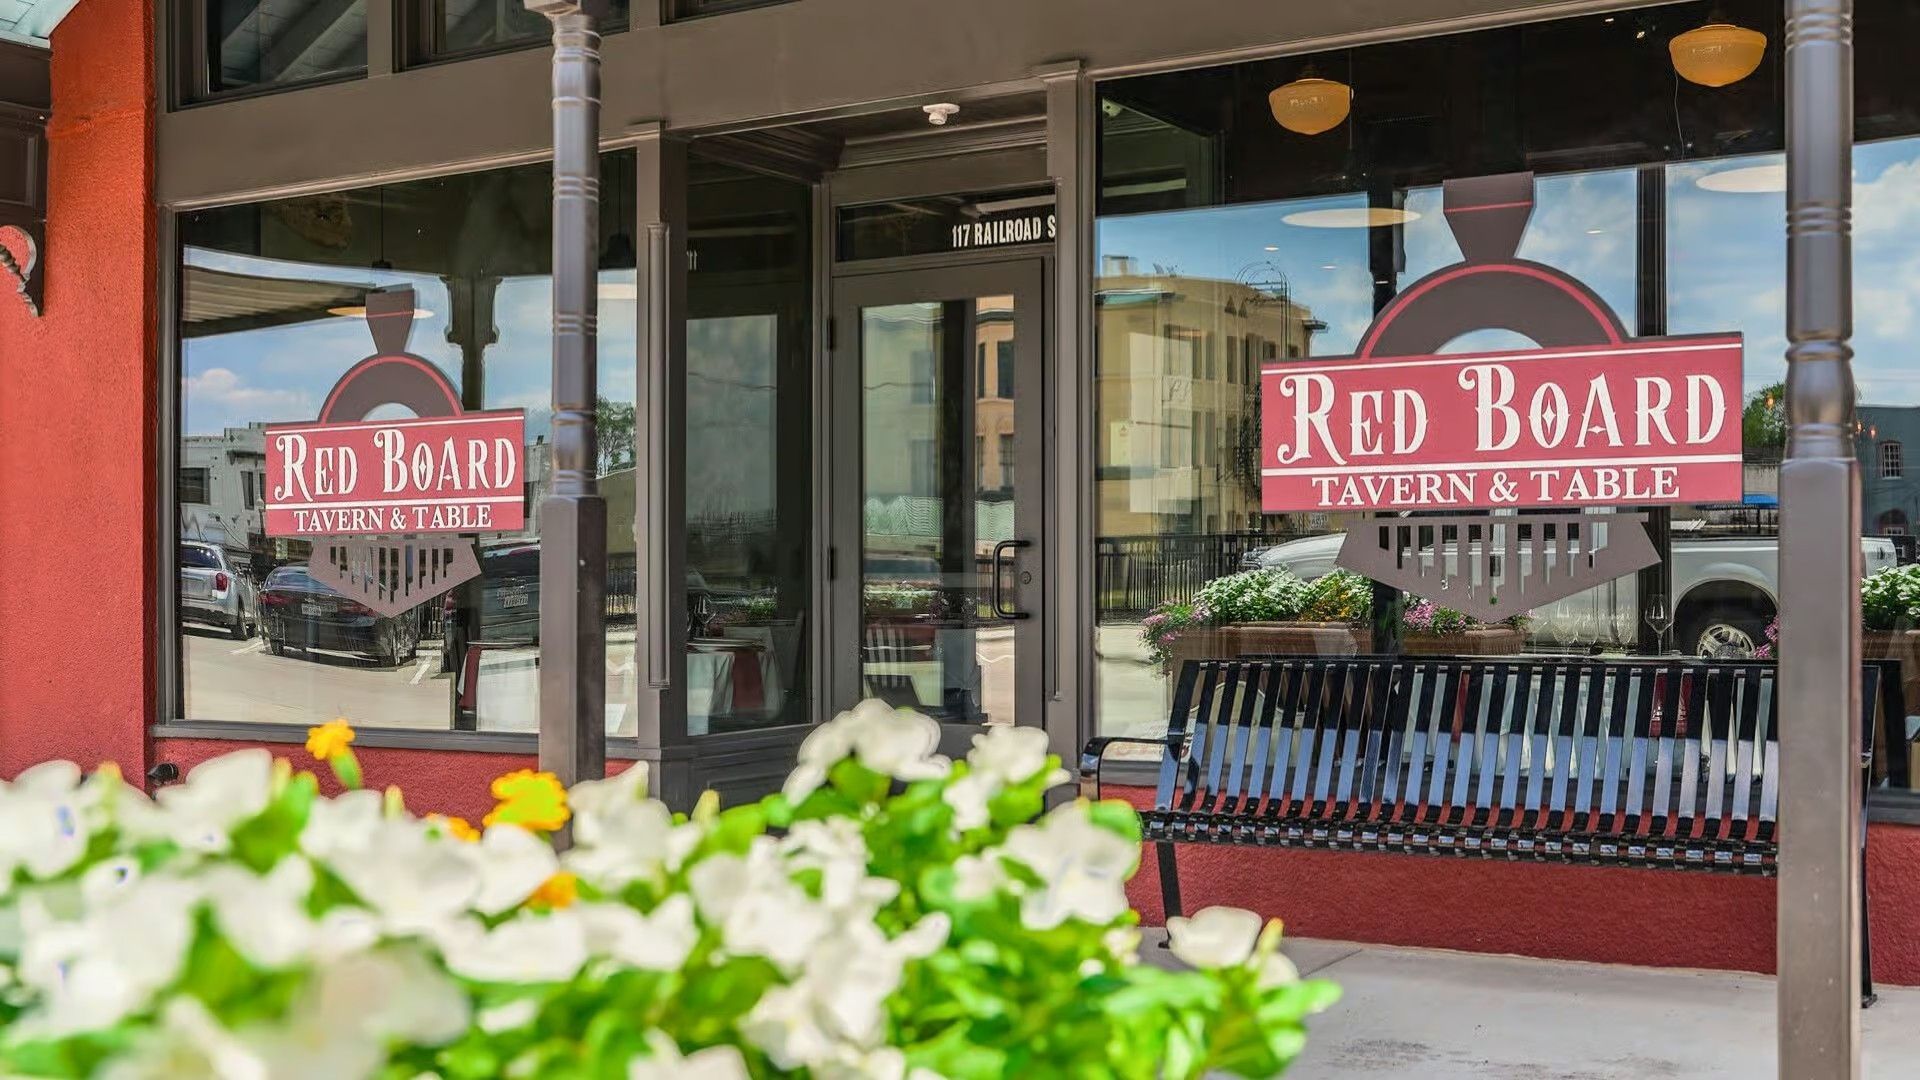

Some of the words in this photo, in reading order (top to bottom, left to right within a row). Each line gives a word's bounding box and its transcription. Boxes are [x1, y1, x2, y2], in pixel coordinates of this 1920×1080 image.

[952, 223, 970, 248] 117
[974, 216, 1042, 246] RAILROAD
[1277, 373, 1429, 465] RED
[1457, 363, 1727, 452] BOARD
[274, 433, 358, 502] RED
[373, 428, 517, 493] BOARD
[1311, 472, 1478, 507] TAVERN
[1488, 471, 1519, 503] &
[1530, 466, 1680, 502] TABLE
[293, 507, 385, 532] TAVERN
[389, 509, 406, 530] &
[412, 504, 492, 529] TABLE
